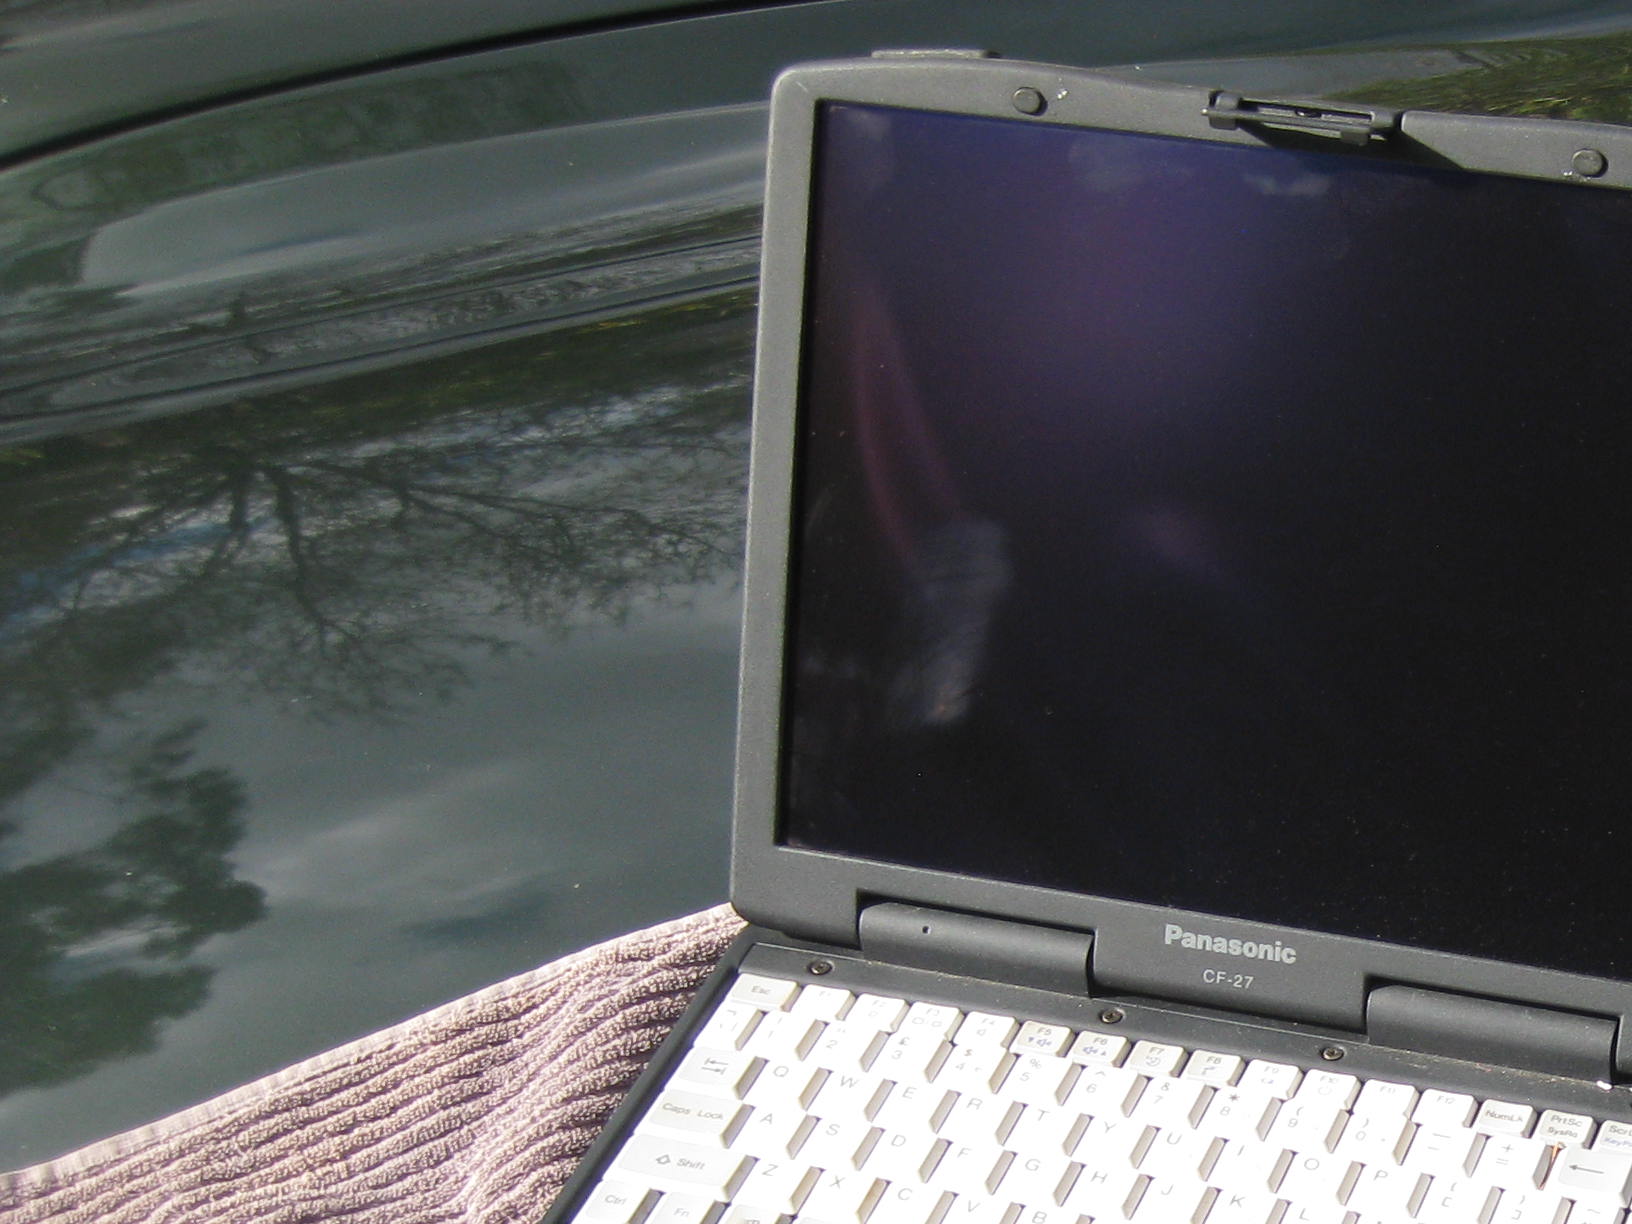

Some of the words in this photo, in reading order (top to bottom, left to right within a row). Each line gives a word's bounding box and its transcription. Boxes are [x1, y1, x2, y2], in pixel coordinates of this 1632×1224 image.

[1164, 923, 1297, 965] Panasonic
[1202, 968, 1254, 989] CF-27
[751, 984, 770, 995] Esc
[1037, 1027, 1052, 1036] F5
[825, 1039, 838, 1050] 2
[1093, 1037, 1108, 1046] F6
[891, 1050, 903, 1060] 3
[1150, 1047, 1165, 1056] F7
[772, 1065, 790, 1078] Q
[1019, 1071, 1032, 1082] 5
[839, 1075, 860, 1089] W
[1085, 1083, 1098, 1094] 6
[901, 1086, 918, 1100] E
[966, 1097, 983, 1111] R
[662, 1102, 691, 1115] Caps
[696, 1108, 724, 1121] Lock
[759, 1112, 774, 1125] A
[1036, 1108, 1051, 1123] T
[1219, 1106, 1231, 1117] 8
[1102, 1120, 1117, 1134] Y
[1287, 1117, 1299, 1128] 9
[1550, 1113, 1583, 1128] PrtSc
[825, 1123, 840, 1137] S
[890, 1134, 907, 1148] D
[1166, 1132, 1183, 1146] U
[956, 1147, 973, 1159] F
[676, 1157, 706, 1171] Shift
[761, 1163, 779, 1177] Z
[1024, 1158, 1041, 1172] G
[1303, 1157, 1320, 1171] O
[828, 1175, 845, 1189] X
[1091, 1170, 1108, 1184] H
[1373, 1169, 1389, 1181] P
[897, 1187, 913, 1202] C
[1160, 1184, 1175, 1196] J
[604, 1194, 627, 1206] Ctrl
[966, 1200, 981, 1214] V
[1229, 1195, 1246, 1208] K
[673, 1207, 690, 1218] Fn
[1031, 1210, 1048, 1224] B
[1298, 1208, 1311, 1222] L
